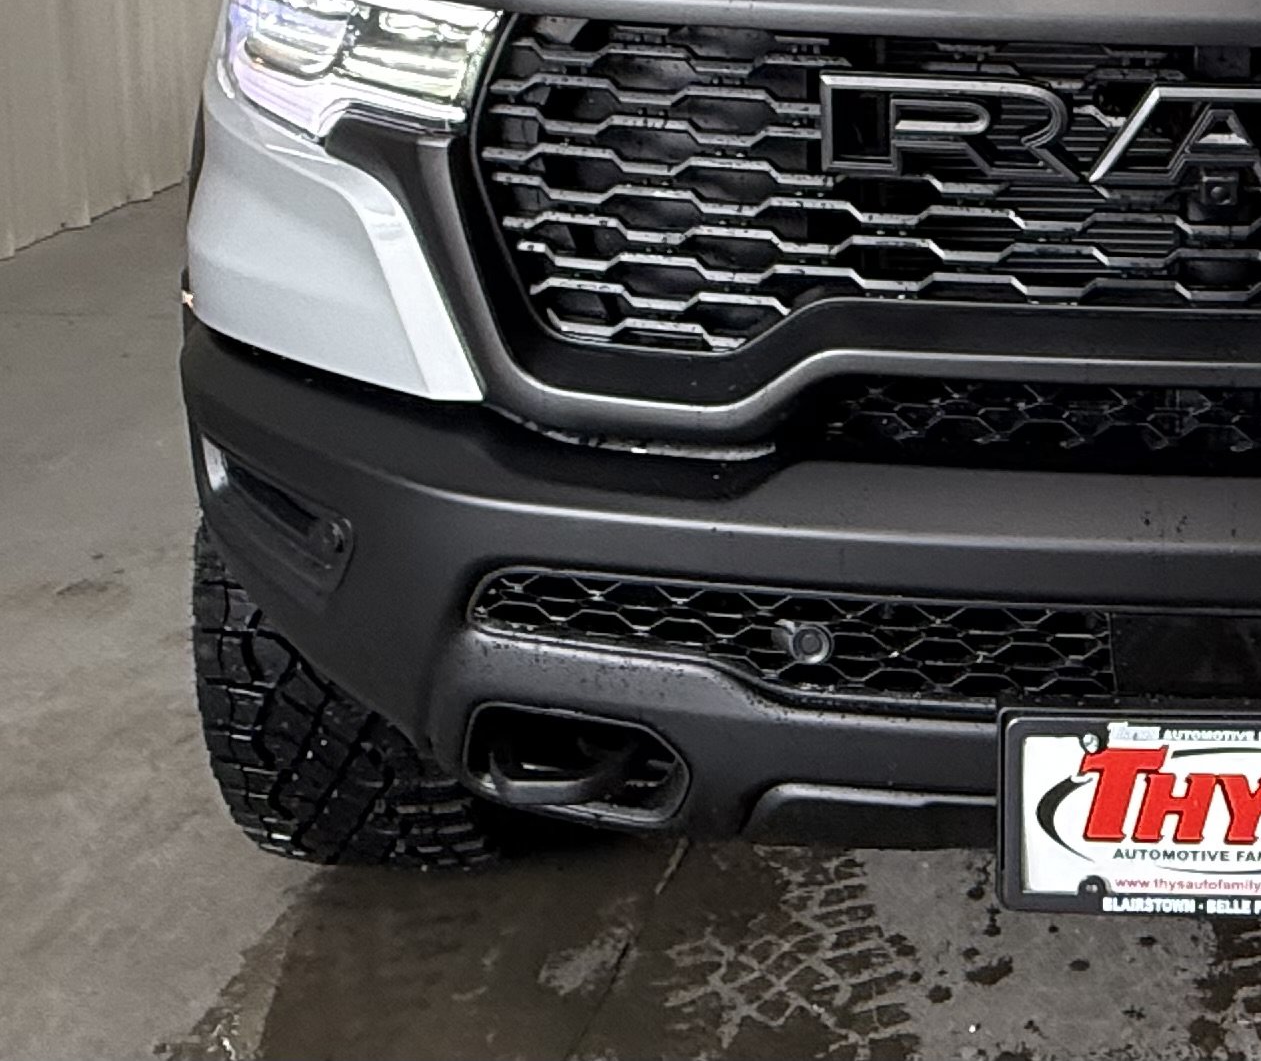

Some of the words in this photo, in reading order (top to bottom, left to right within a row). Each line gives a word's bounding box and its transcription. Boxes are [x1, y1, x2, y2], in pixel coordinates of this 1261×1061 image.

[1163, 728, 1256, 742] AUTOMOTIVE
[1112, 848, 1230, 862] AUTOMOTIVE
[1102, 896, 1196, 913] BLAIRSTOWN
[1206, 898, 1252, 915] BELLE
